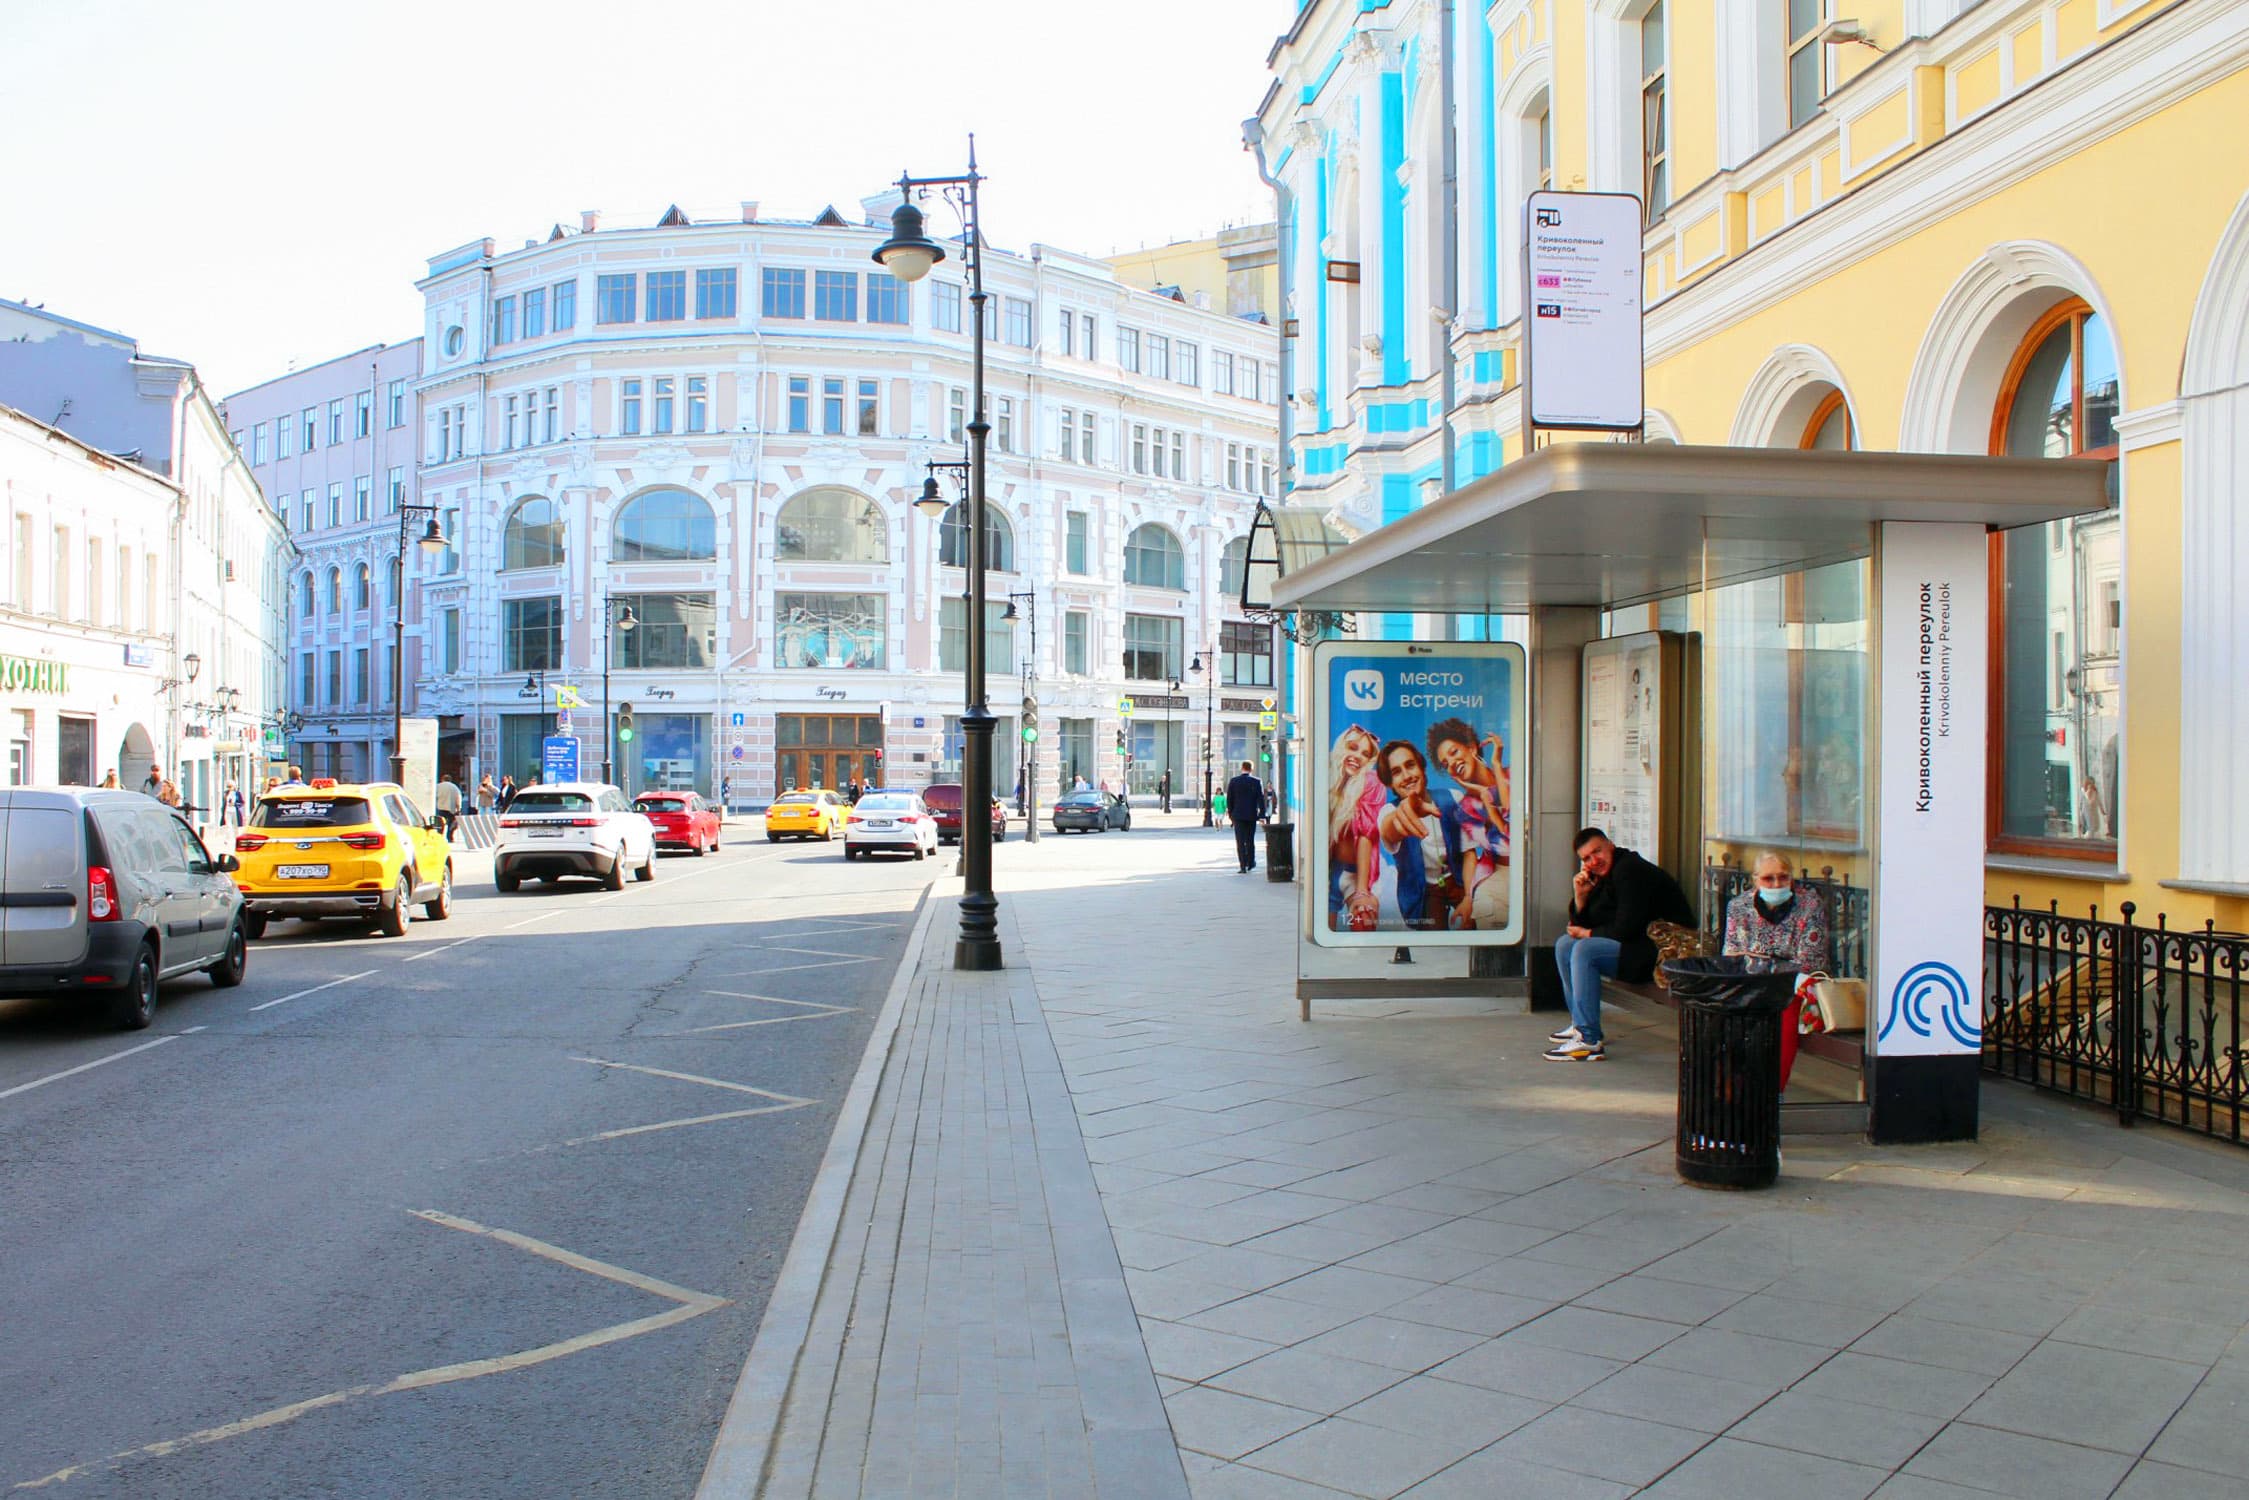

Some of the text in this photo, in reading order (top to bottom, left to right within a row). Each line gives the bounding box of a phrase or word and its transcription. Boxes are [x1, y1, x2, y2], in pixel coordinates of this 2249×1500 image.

[1537, 236, 1604, 245] Кривоколенный
[1537, 245, 1576, 253] переулок
[1938, 582, 1952, 737] Krivokolenniy Pereulok
[1400, 672, 1463, 686] место
[1351, 681, 1378, 699] VK
[1916, 582, 1934, 812] Кривоколенный переулок
[1400, 694, 1484, 711] встречи
[1341, 912, 1363, 926] 12+
